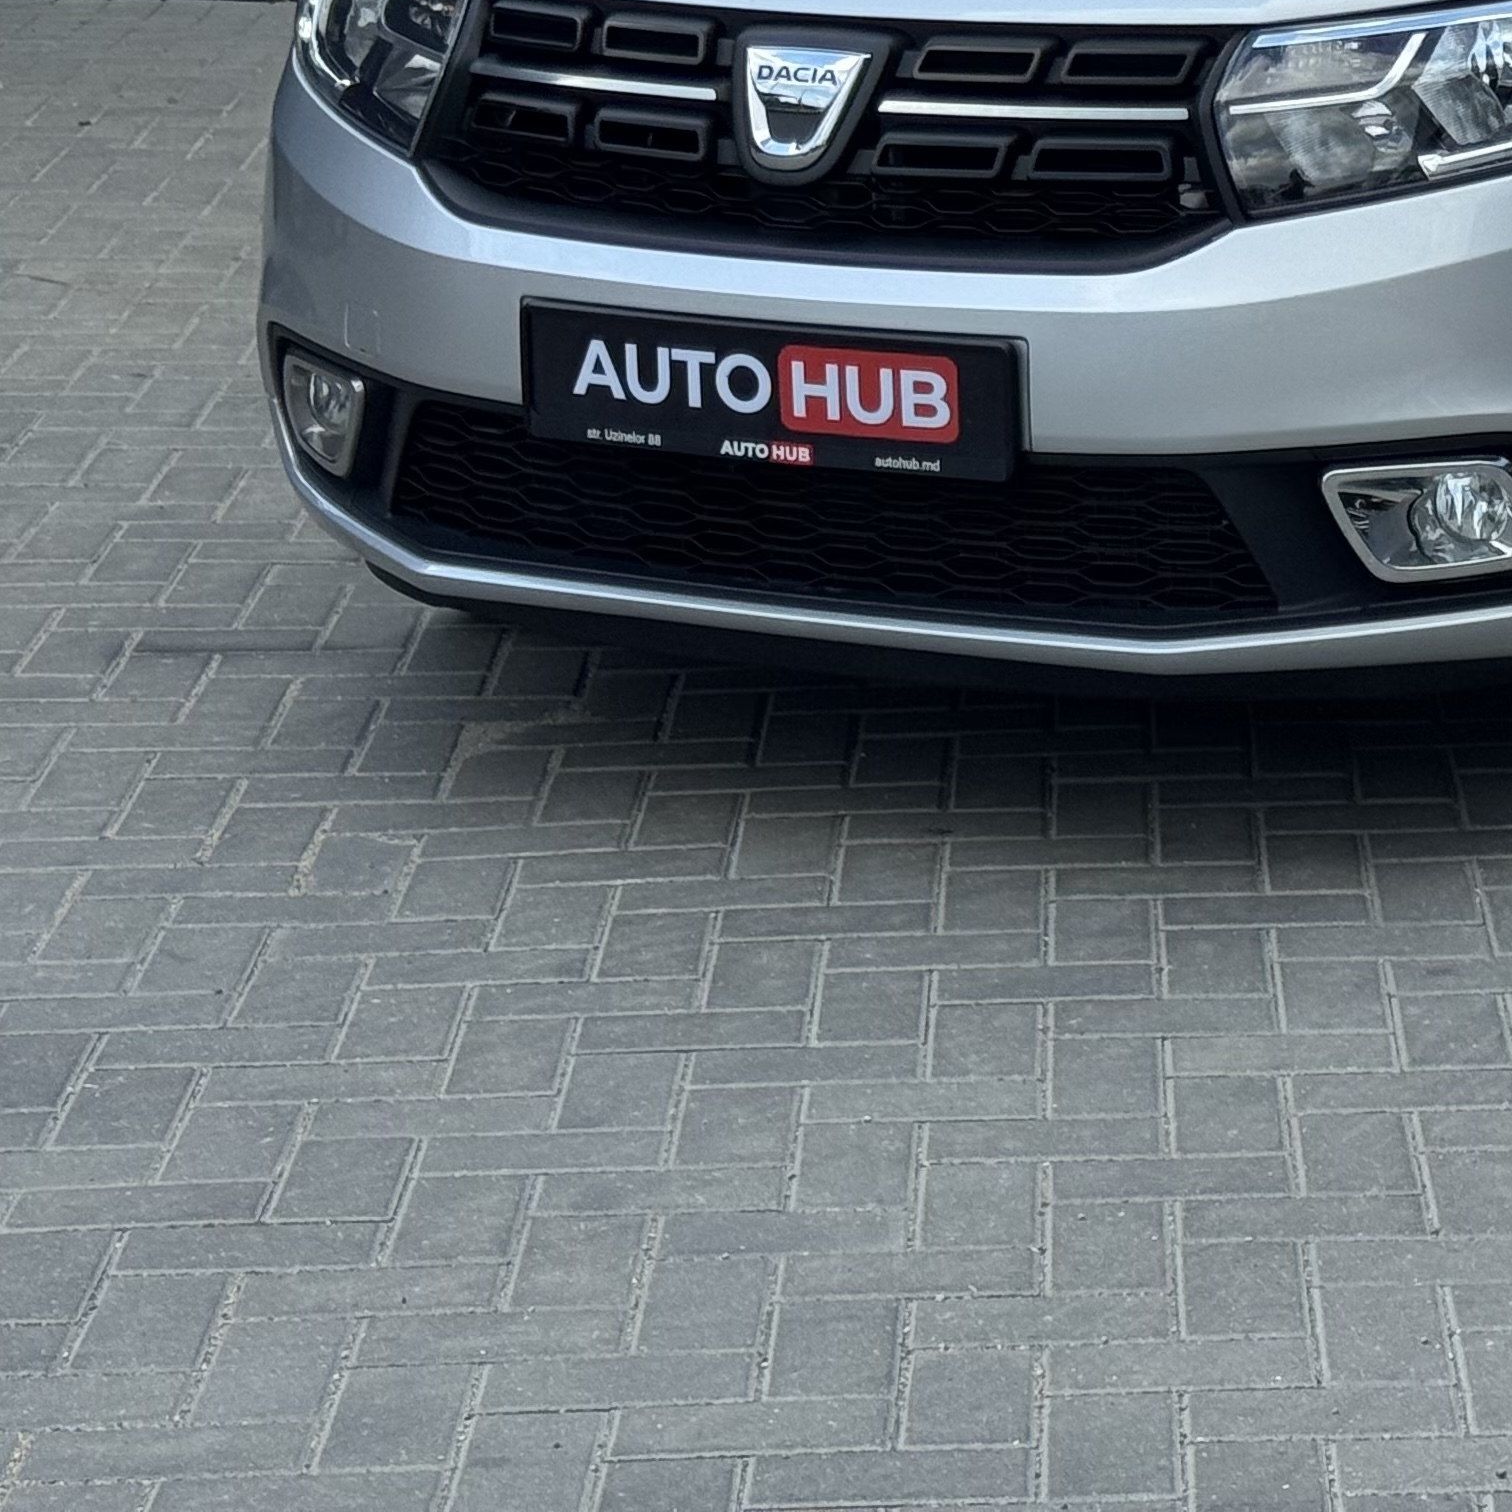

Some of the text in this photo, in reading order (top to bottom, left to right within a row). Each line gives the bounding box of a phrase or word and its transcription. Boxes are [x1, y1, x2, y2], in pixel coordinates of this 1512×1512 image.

[756, 64, 838, 87] DACIA
[572, 338, 952, 429] AUTO HUB
[604, 428, 646, 445] Uzinelor
[720, 439, 811, 462] AUTO HUB
[874, 456, 941, 473] autohub.md
